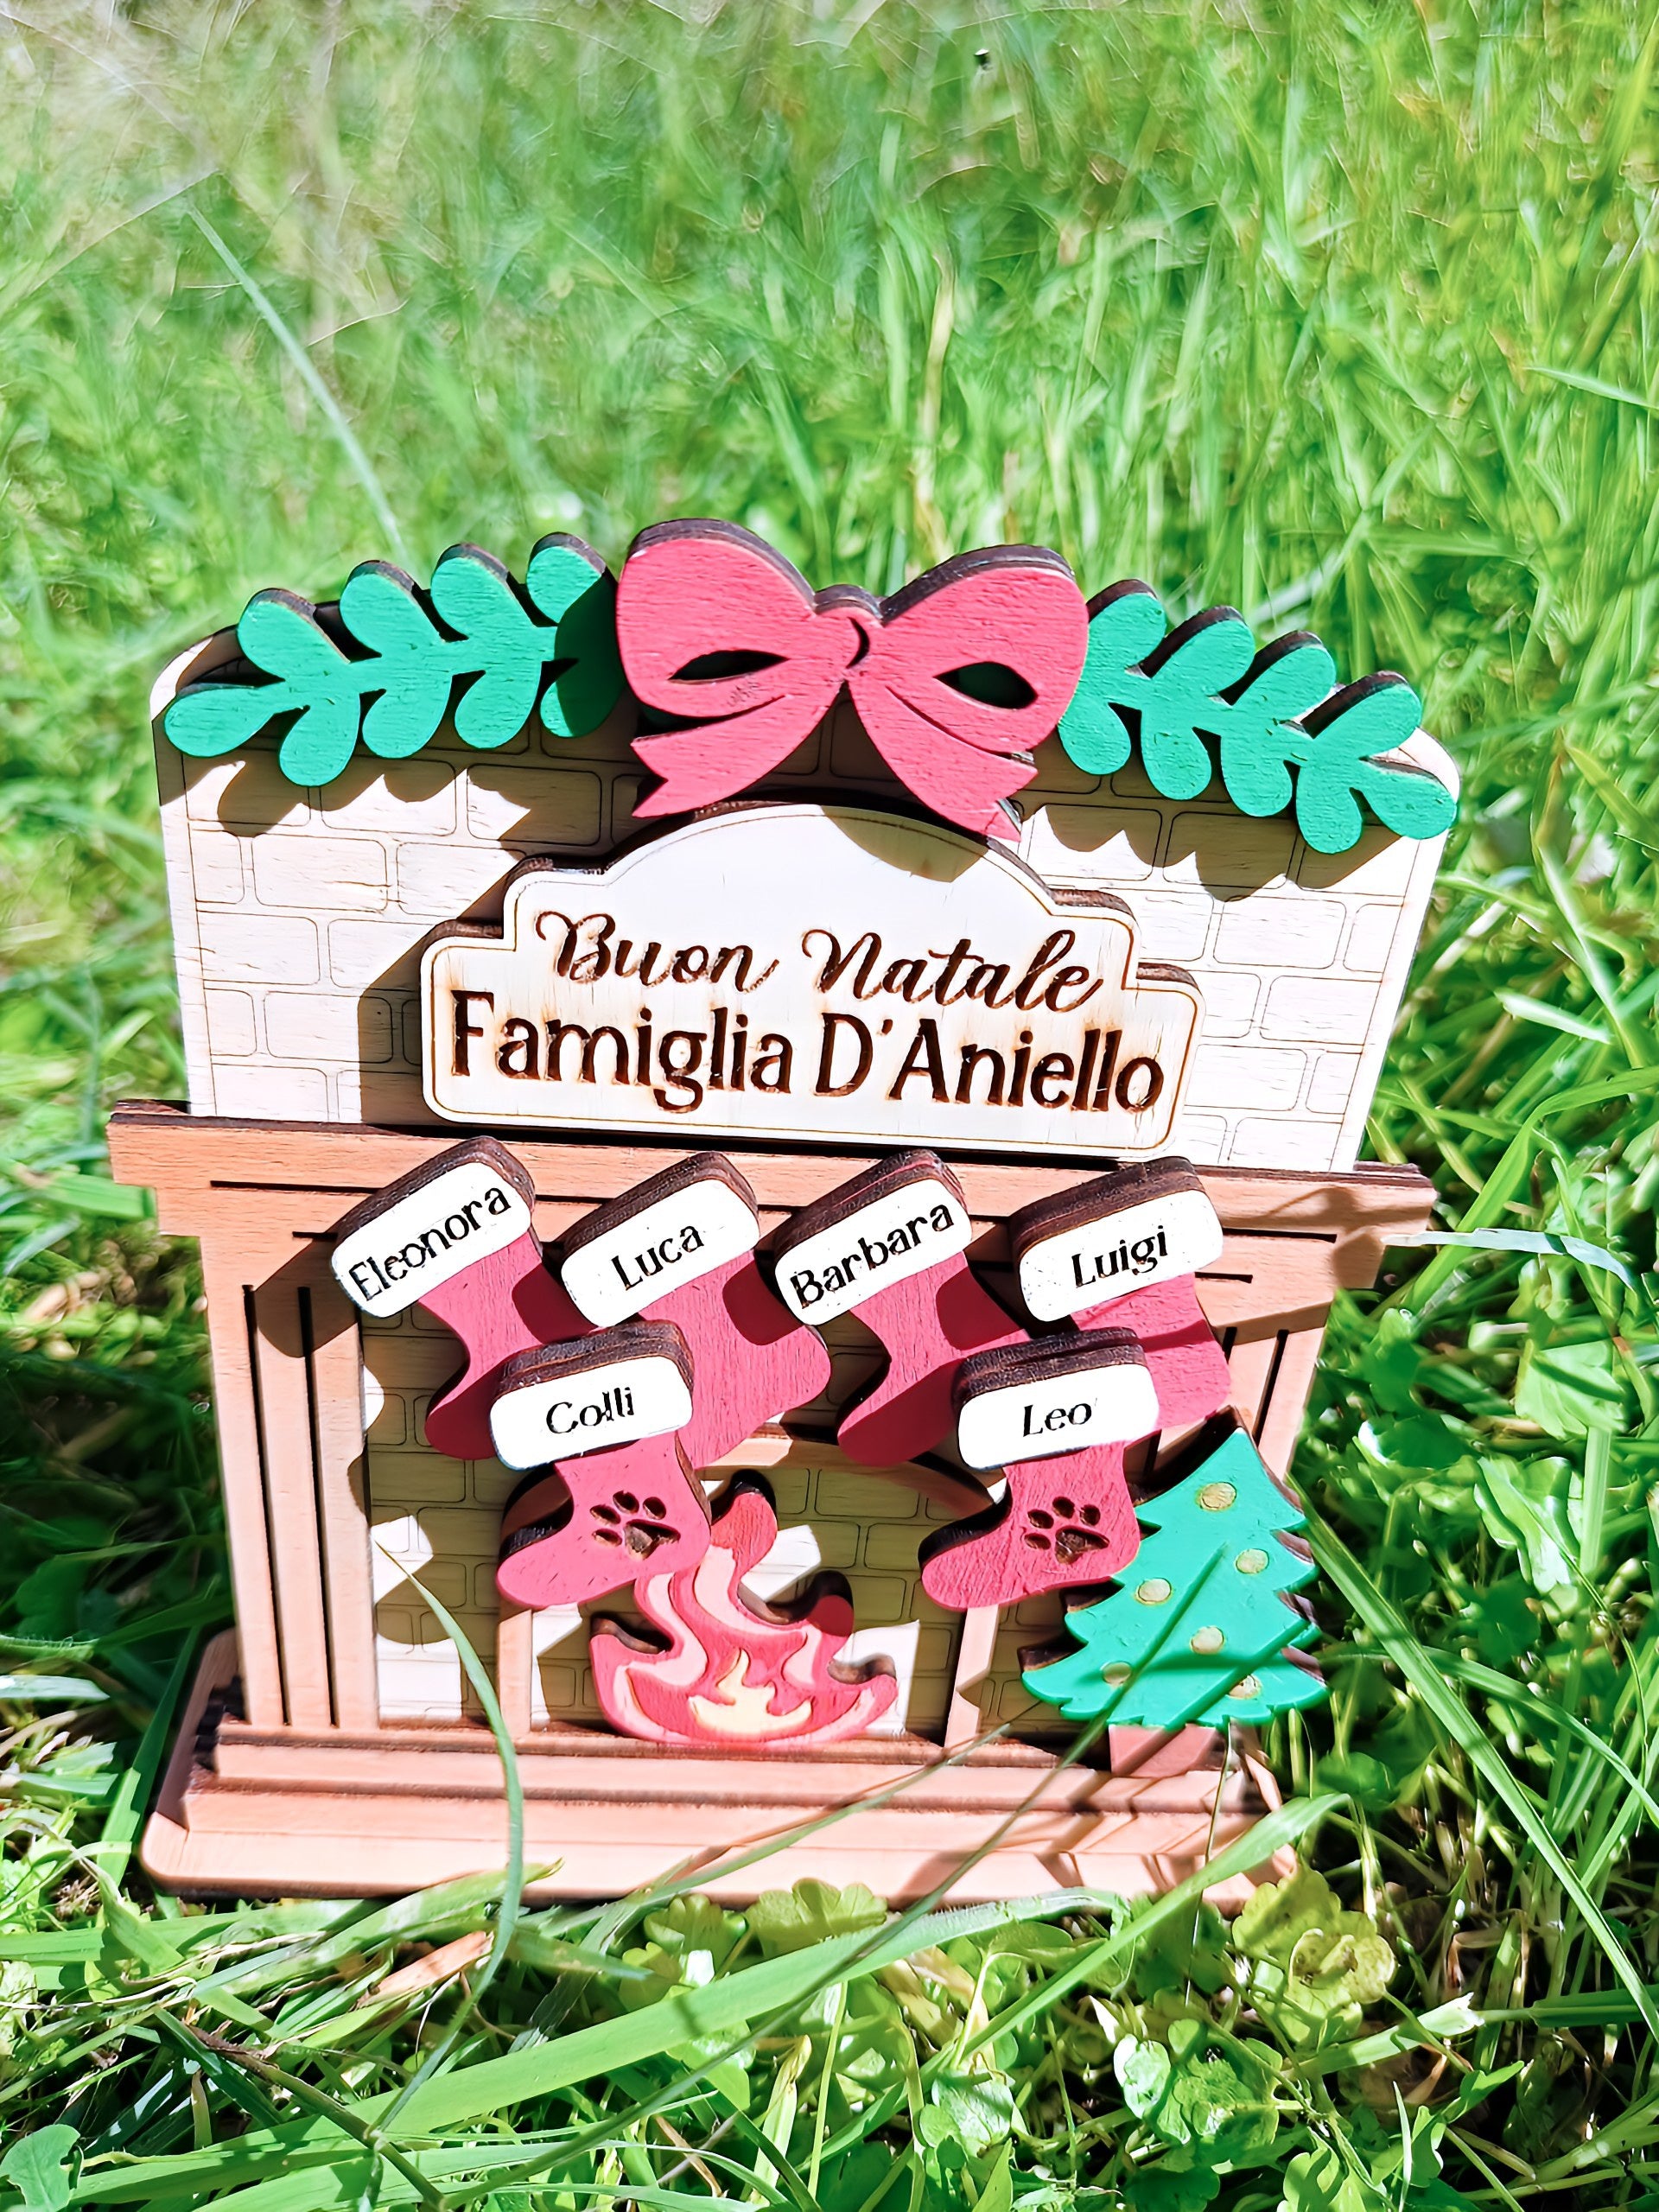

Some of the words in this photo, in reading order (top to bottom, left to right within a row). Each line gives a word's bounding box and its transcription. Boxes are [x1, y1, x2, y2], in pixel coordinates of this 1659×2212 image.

[533, 910, 780, 993] Buon
[802, 928, 1104, 1013] Natale
[450, 989, 792, 1115] Famiglia
[813, 1012, 1165, 1114] D'Aniello
[347, 1185, 512, 1302] Eleonora
[609, 1224, 706, 1291] Luca
[789, 1203, 955, 1309] Barbara
[1070, 1224, 1168, 1288] Luigi
[545, 1386, 635, 1434] Colli
[1022, 1401, 1093, 1437] Leo
